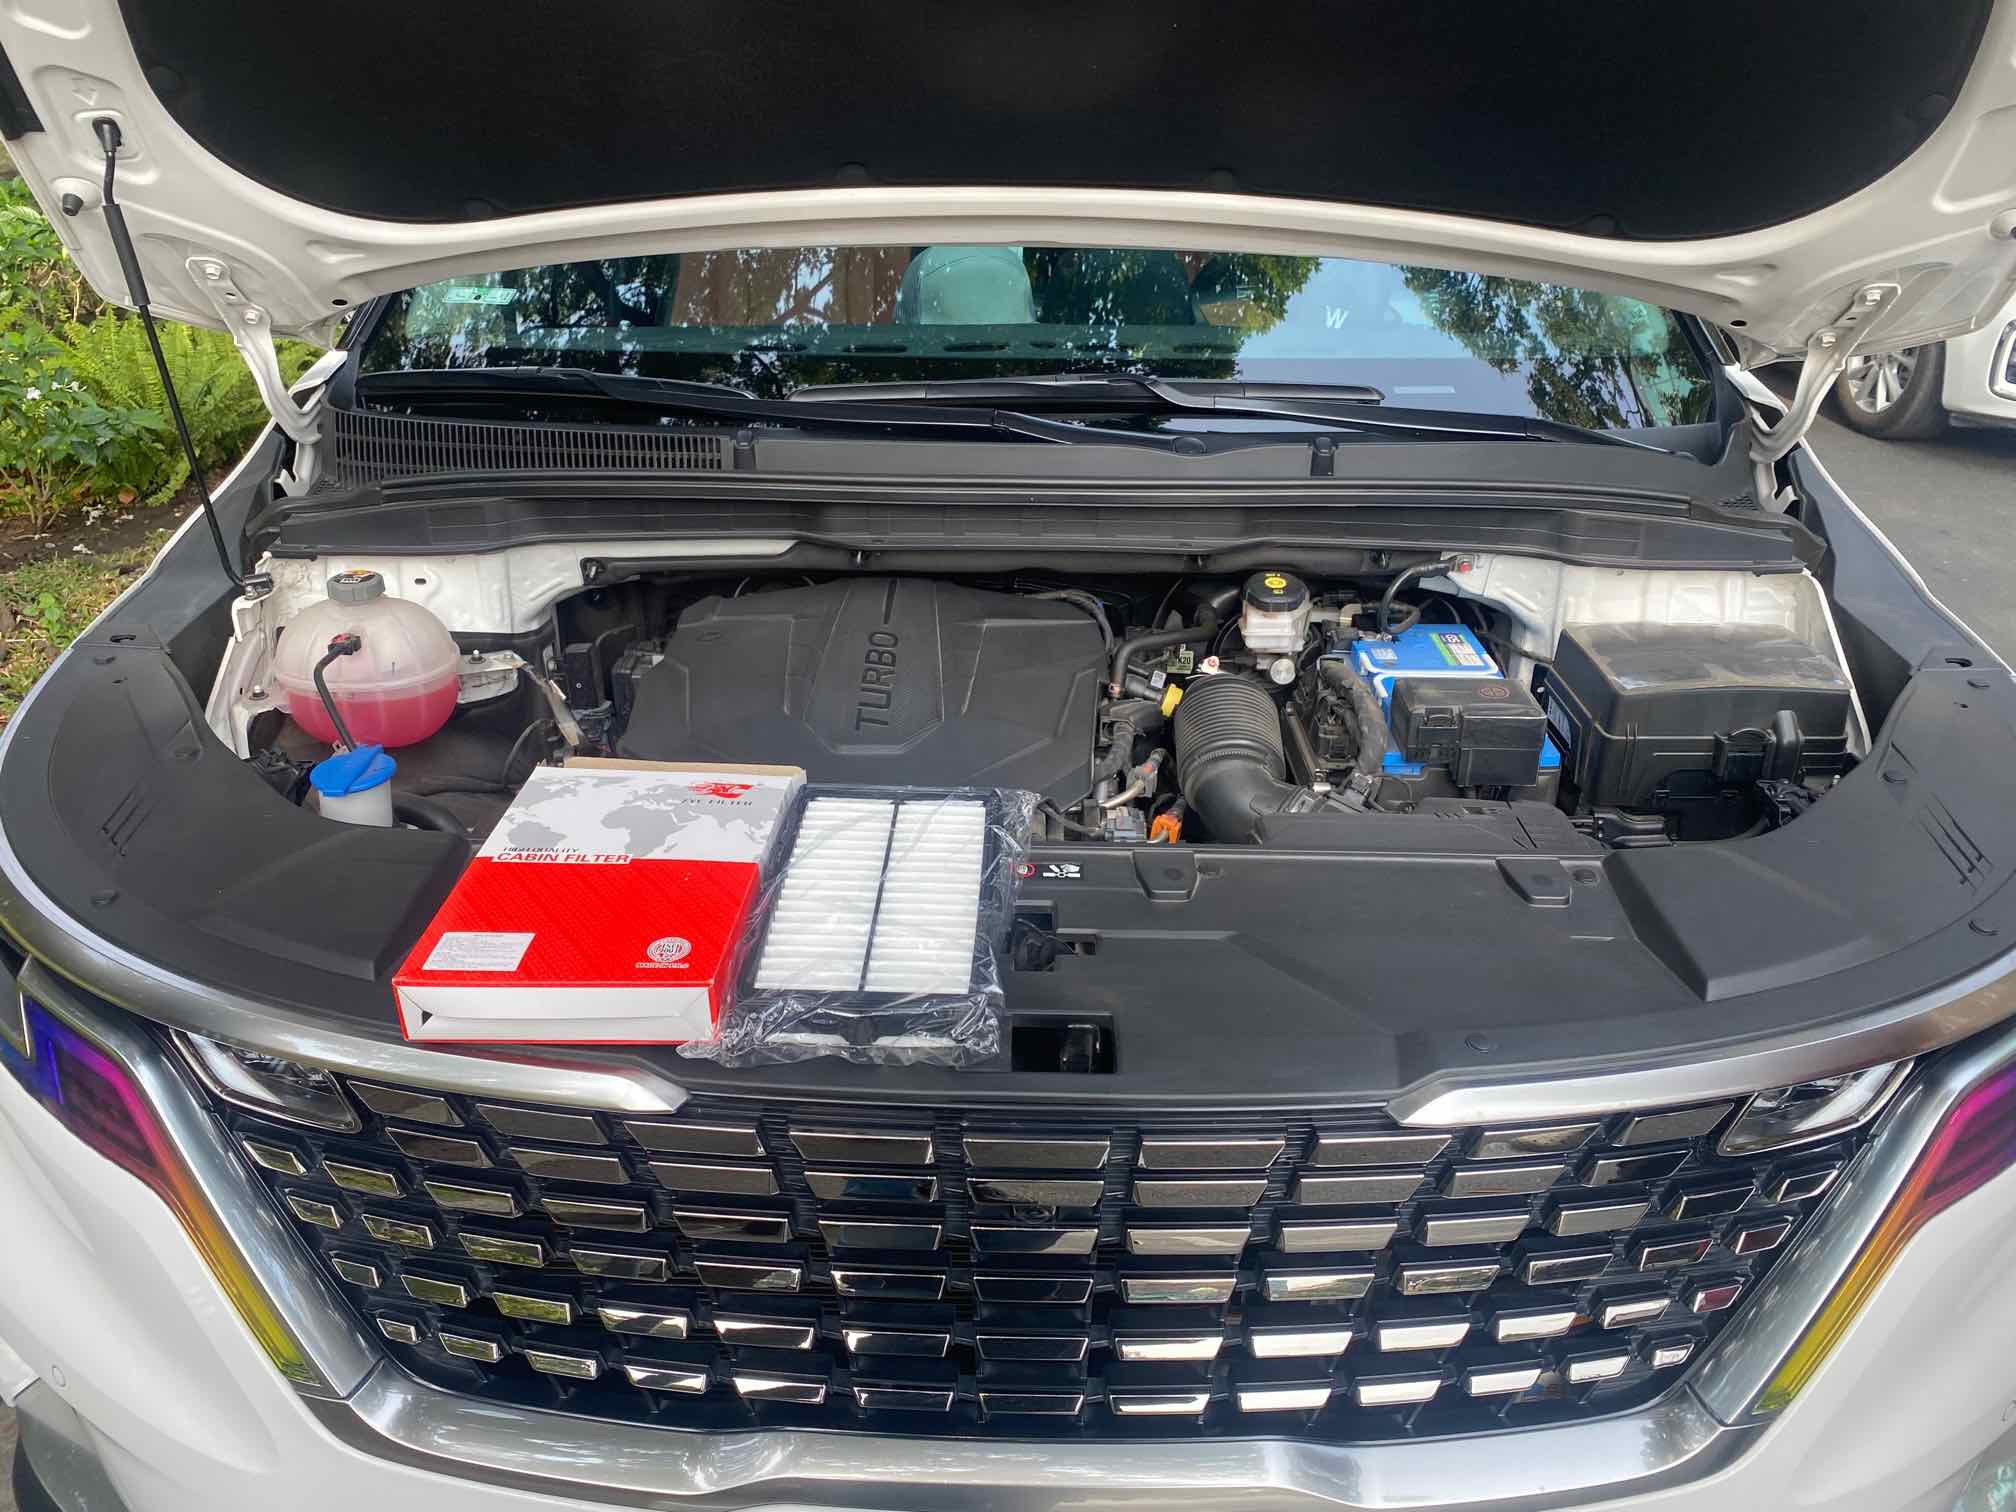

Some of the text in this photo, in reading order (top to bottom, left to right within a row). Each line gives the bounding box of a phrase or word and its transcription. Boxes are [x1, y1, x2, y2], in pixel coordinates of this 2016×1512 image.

[855, 631, 898, 731] TURBO
[497, 853, 630, 863] CABIN FILTER
